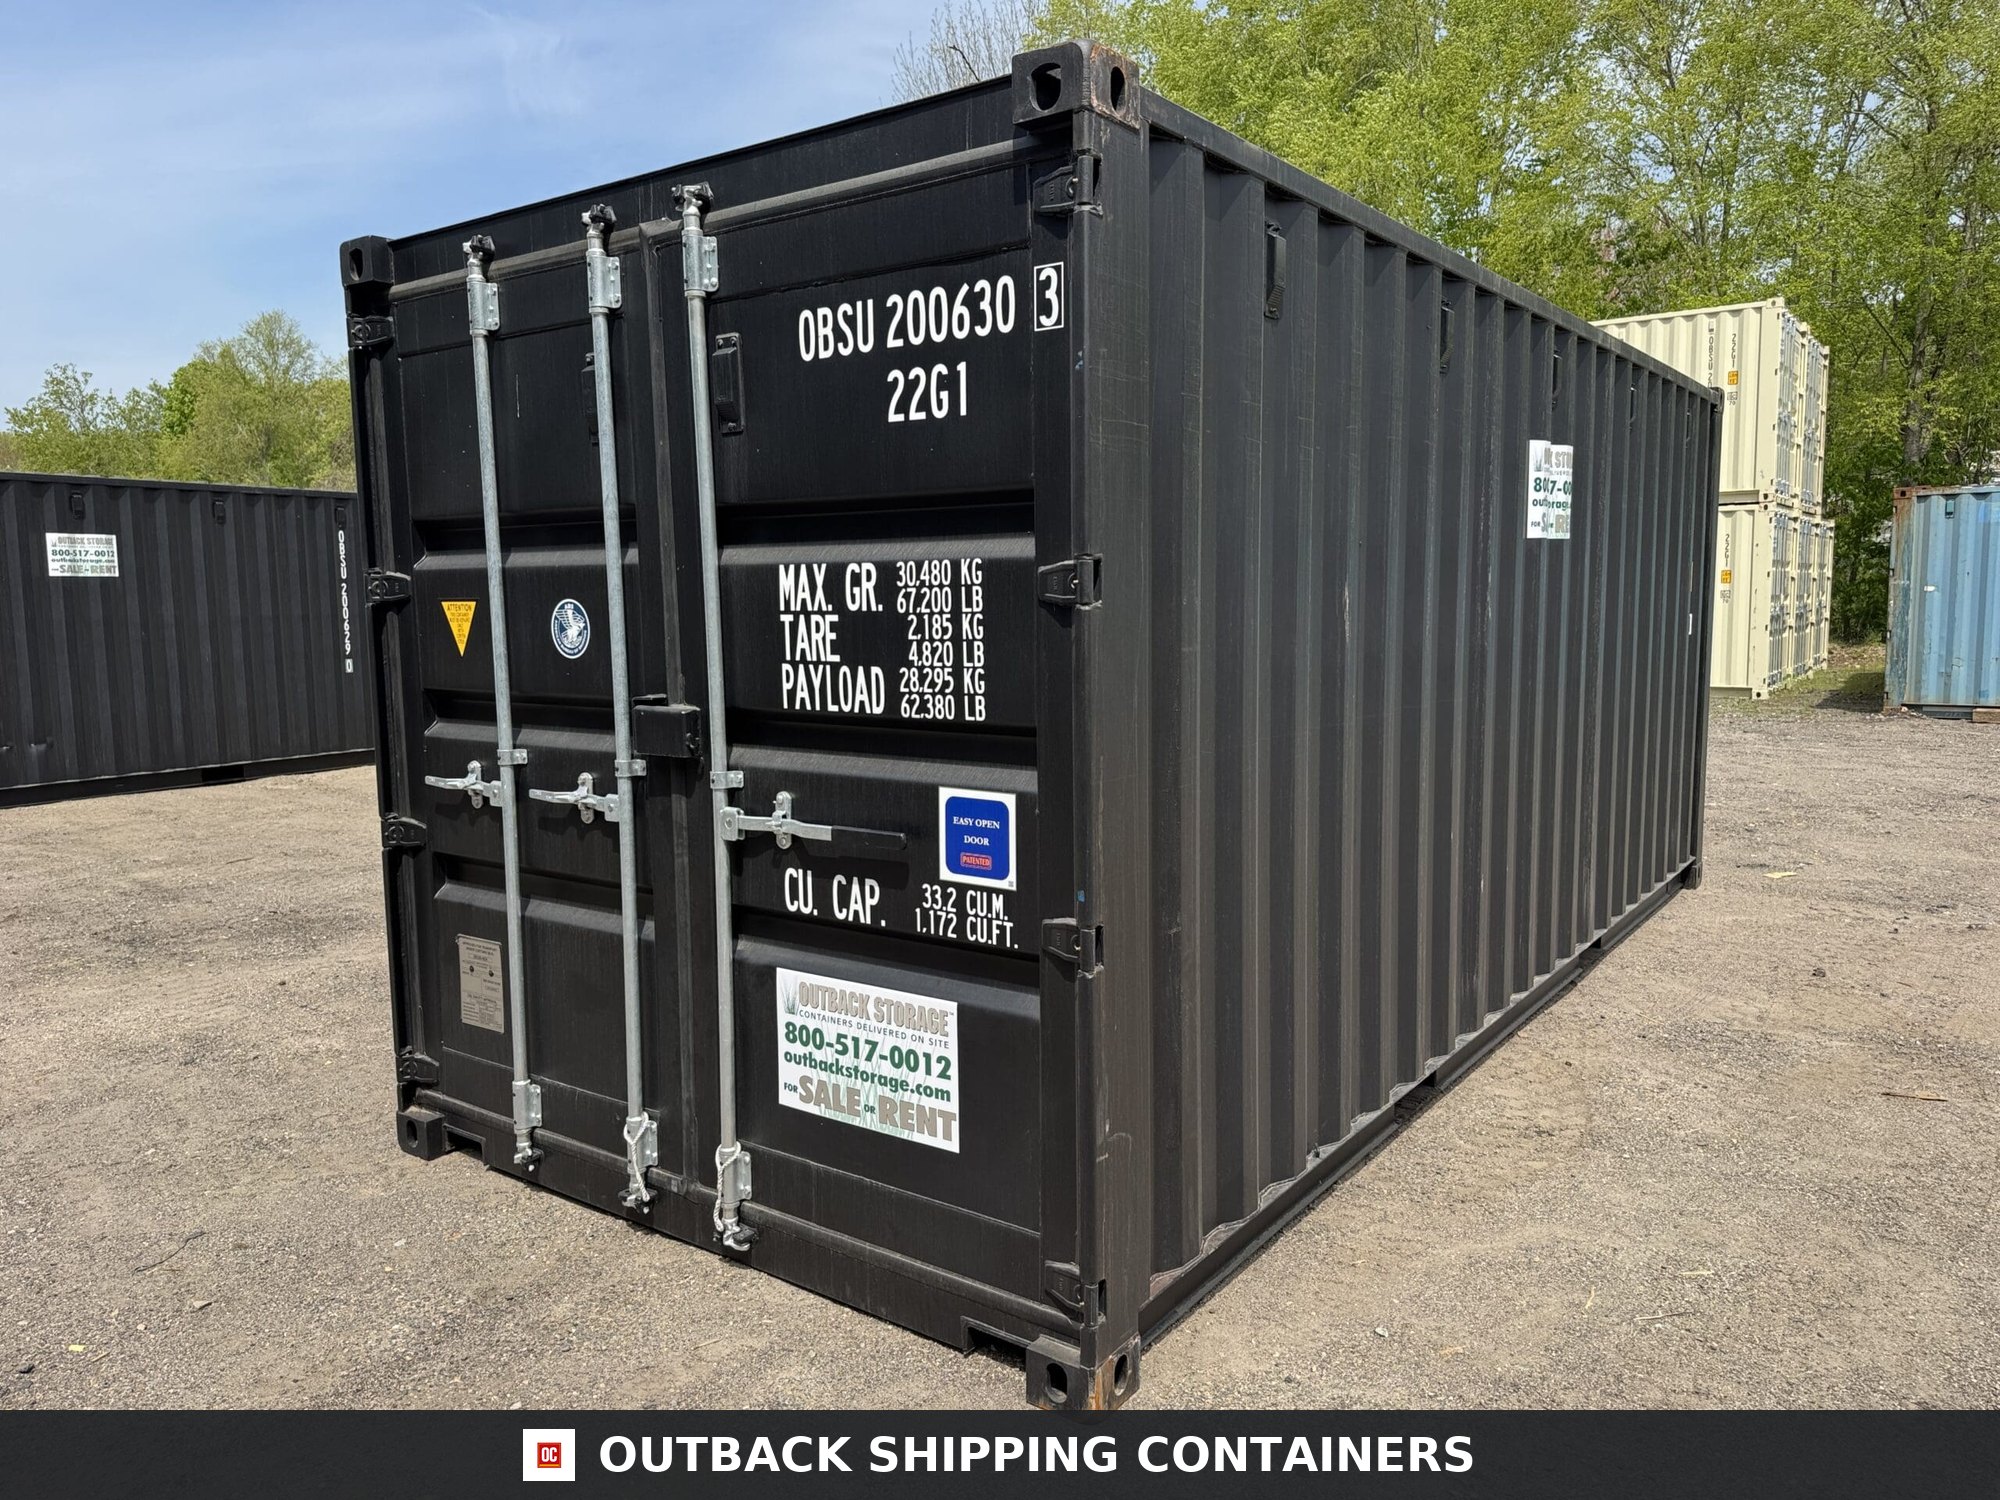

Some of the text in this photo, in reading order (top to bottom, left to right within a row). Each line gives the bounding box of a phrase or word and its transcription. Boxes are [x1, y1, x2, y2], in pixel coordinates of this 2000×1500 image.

[799, 267, 1059, 361] OBSU 200630 3
[887, 361, 967, 423] 22G1
[51, 549, 115, 557] 800-517-0012
[59, 564, 84, 574] SALE
[338, 530, 347, 579] OBSU
[896, 558, 983, 587] 30,480 KG
[779, 562, 883, 612] MAX. GR.
[896, 586, 984, 614] 67,200 LB
[341, 582, 351, 655] 200629
[780, 614, 841, 662] TARE
[907, 613, 984, 640] 2,185 KG
[908, 641, 985, 667] 4,820 LB
[781, 663, 885, 714] PAYLOAD
[899, 667, 985, 694] 28,295 KG
[900, 694, 986, 721] 62,380 LB
[953, 816, 1000, 829] EASY OPEN
[963, 835, 990, 846] DOOR
[962, 855, 990, 866] PATENTED
[784, 867, 886, 927] CU. CAP.
[921, 883, 1009, 921] 33.2 CU.M.
[915, 907, 1019, 949] 1,172 CU.FT.
[799, 981, 870, 1021] OUTBACK
[799, 1009, 950, 1049] CONTAINERS DELIVERED ON SITE
[784, 1021, 952, 1081] 800-517-0012
[784, 1050, 951, 1103] outbackstorage.com
[784, 1075, 957, 1142] FOR SALE OR RENT
